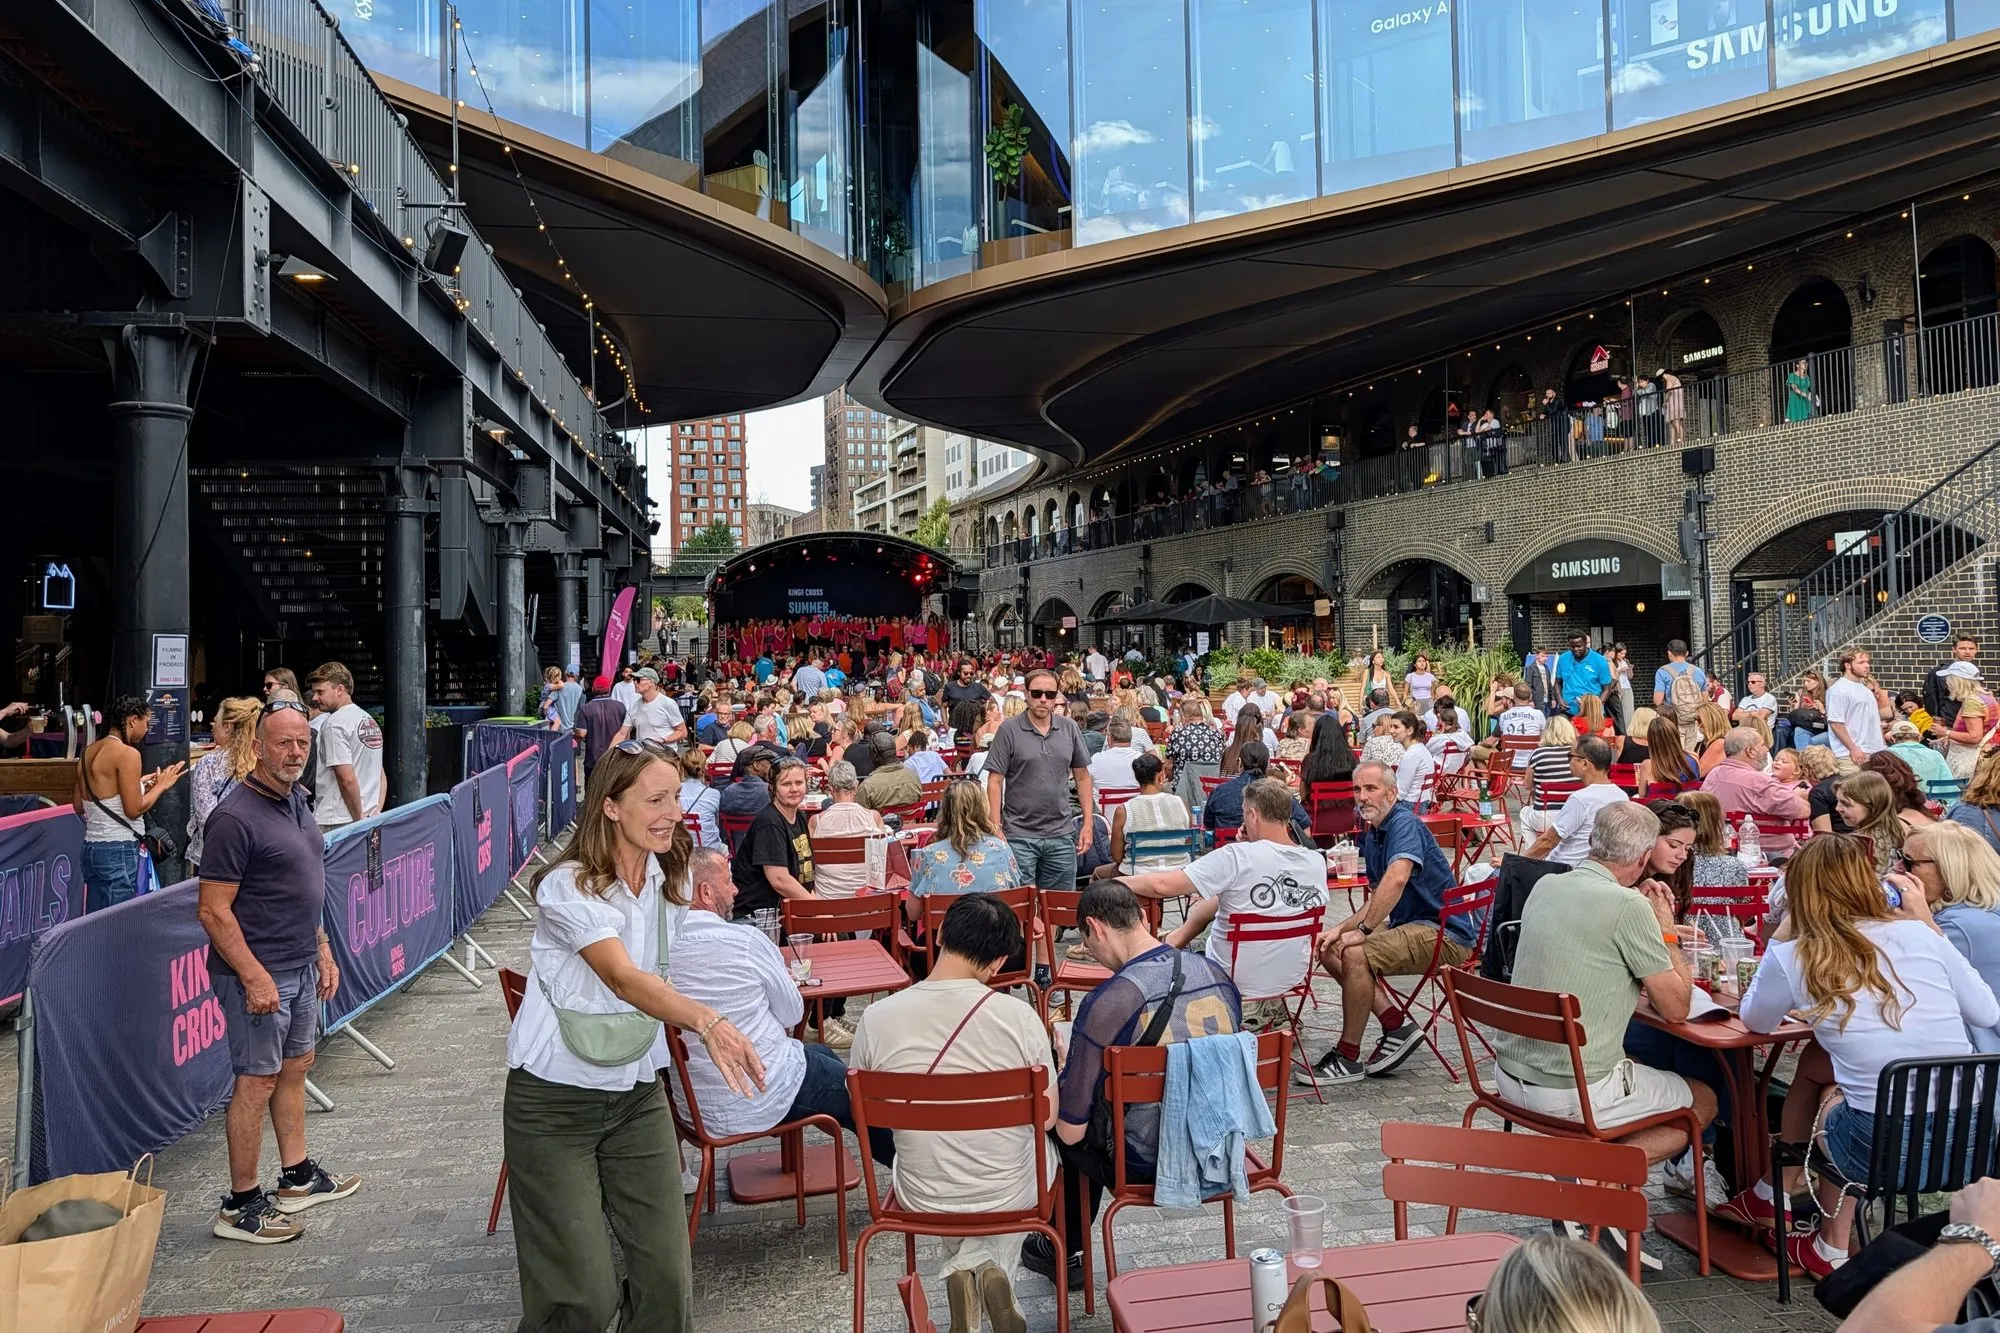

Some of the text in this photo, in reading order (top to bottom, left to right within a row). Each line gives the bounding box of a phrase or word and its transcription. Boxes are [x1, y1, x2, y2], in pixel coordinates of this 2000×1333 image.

[1371, 6, 1432, 33] Galaxy
[1683, 345, 1724, 364] SAMSUNG
[1551, 556, 1621, 579] SAMSUNG
[805, 588, 824, 596] CROSS
[788, 601, 829, 614] SUMMER
[1507, 722, 1527, 735] 94
[0, 854, 71, 945] AILS
[348, 842, 437, 956] CULTURE
[171, 943, 210, 1010] KIN
[173, 995, 227, 1067] CROS
